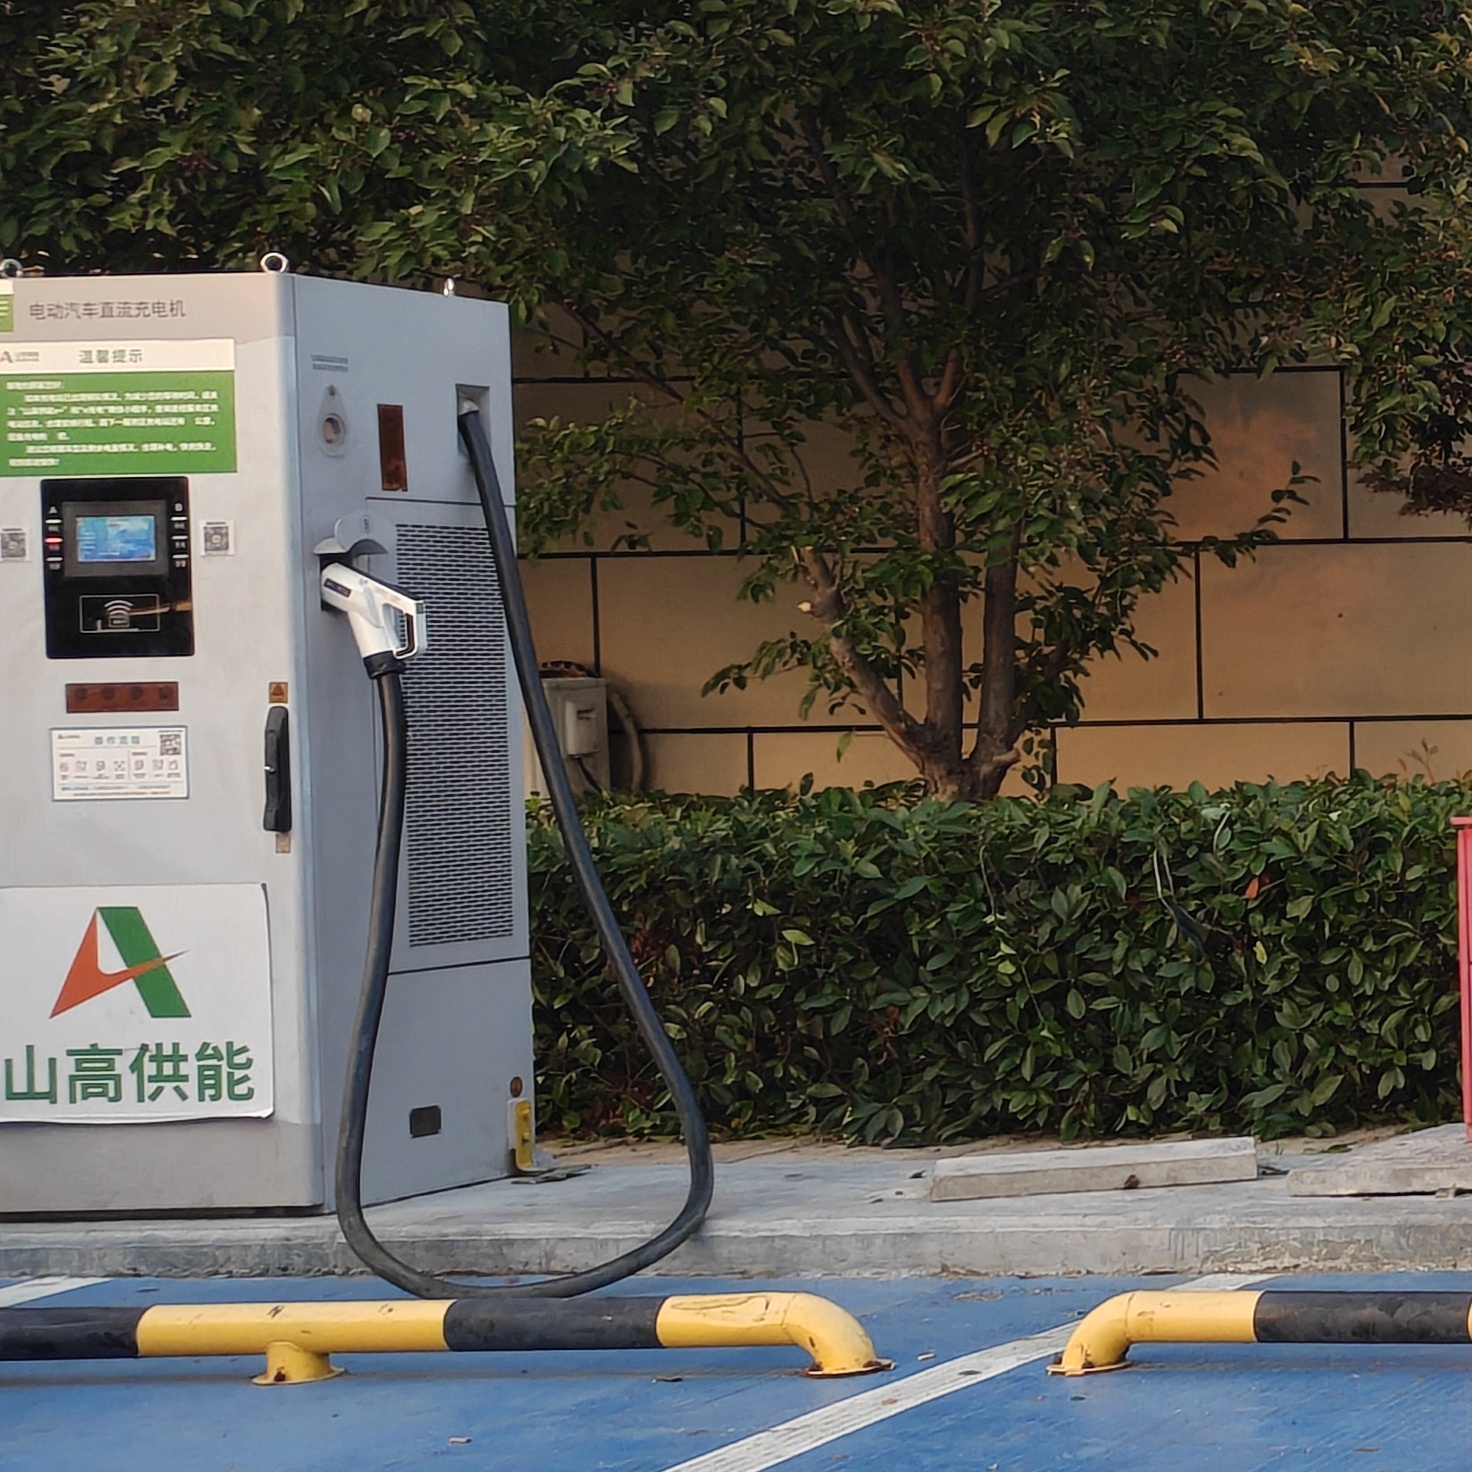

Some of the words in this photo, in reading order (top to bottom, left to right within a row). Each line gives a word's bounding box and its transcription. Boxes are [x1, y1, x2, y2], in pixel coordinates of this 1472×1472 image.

[29, 299, 187, 320] 电动汽车直流充电机
[4, 1041, 255, 1104] 山高供能
